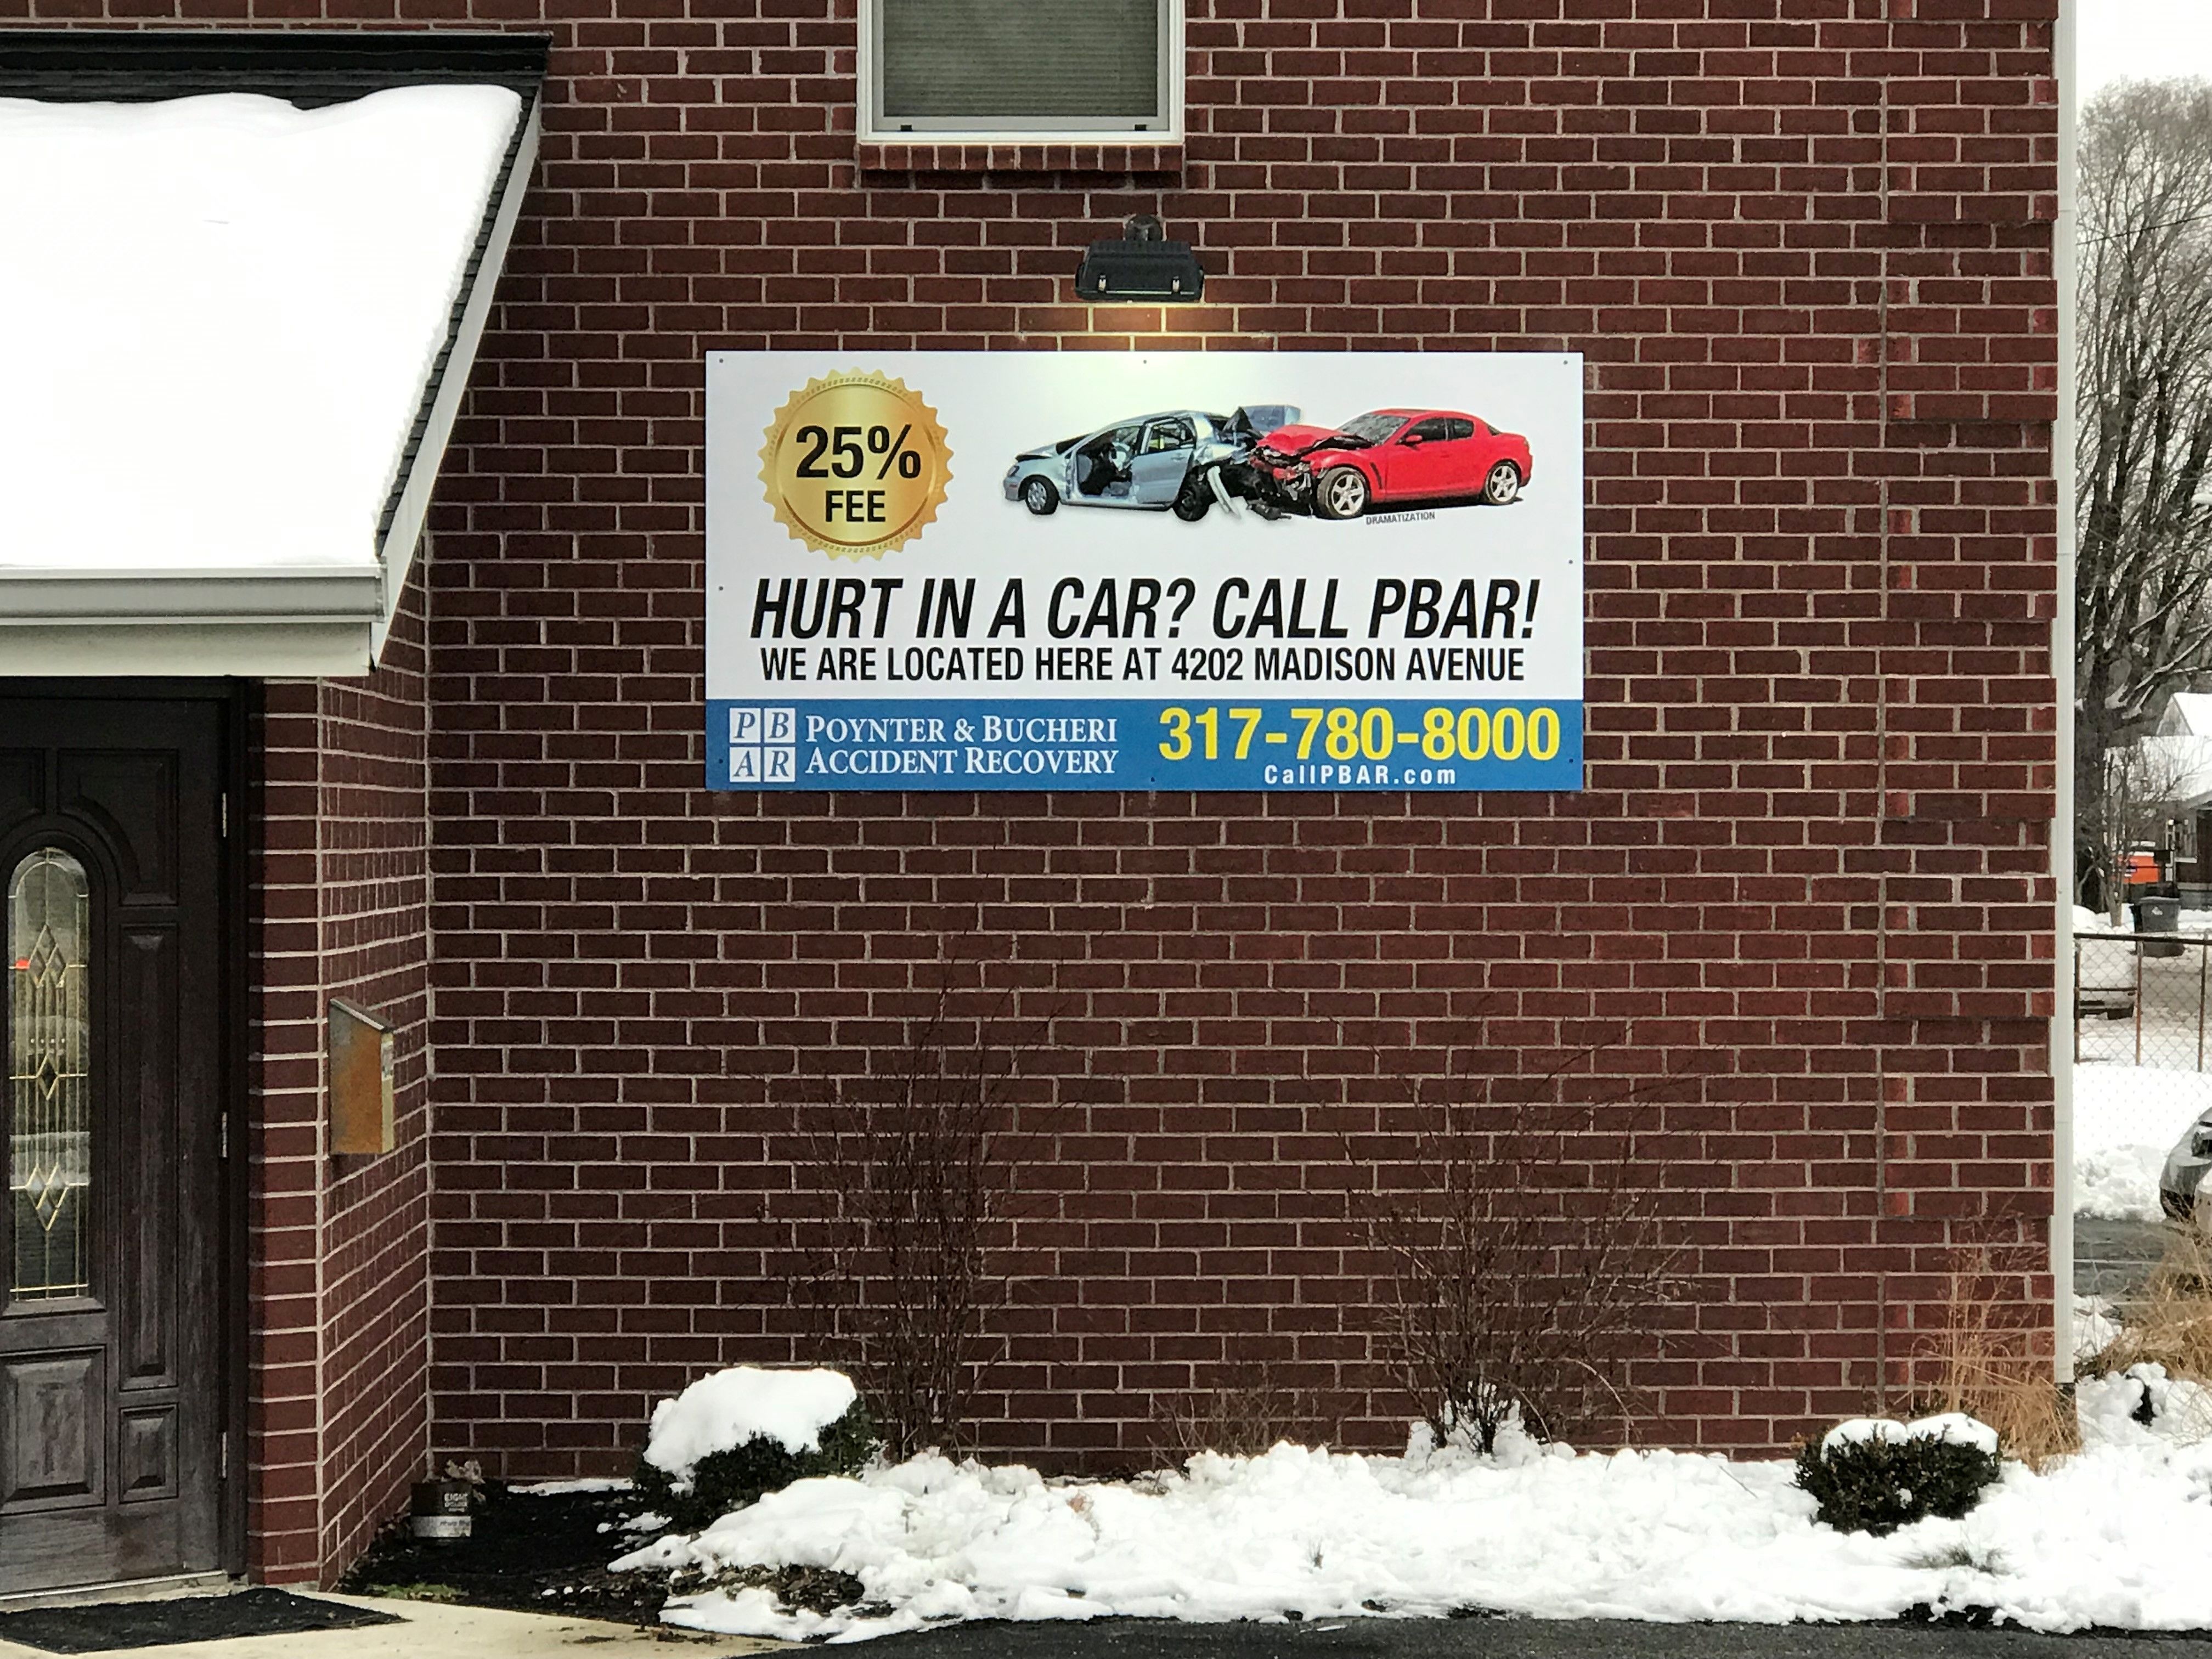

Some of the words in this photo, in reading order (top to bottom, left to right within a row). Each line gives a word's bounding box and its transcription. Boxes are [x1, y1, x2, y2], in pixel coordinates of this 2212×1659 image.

[795, 423, 922, 481] 25%
[825, 490, 886, 522] FEE
[1365, 511, 1436, 526] DRAMATIZATION
[751, 578, 904, 639] HURT
[916, 578, 976, 638] IN
[987, 578, 1025, 638] A
[1048, 577, 1195, 639] CAR?
[1213, 577, 1348, 639] CALL
[1368, 579, 1540, 639] PBAR!
[760, 647, 806, 680] WE
[816, 647, 877, 680] ARE
[888, 647, 1023, 681] LOCATED
[1036, 647, 1113, 680] HERE
[1122, 647, 1162, 680] AT
[1171, 648, 1243, 681] 4202
[1255, 647, 1395, 681] MADISON
[1406, 648, 1524, 681] AVENUE
[806, 715, 946, 742] POYNTER
[953, 718, 975, 742] &
[982, 715, 1117, 742] BUCHERI
[1159, 707, 1560, 760] 317-780-8000
[805, 747, 958, 774] ACCIDENT
[964, 747, 1119, 774] RECOVERY
[1265, 765, 1455, 785] CallPBAR.com
